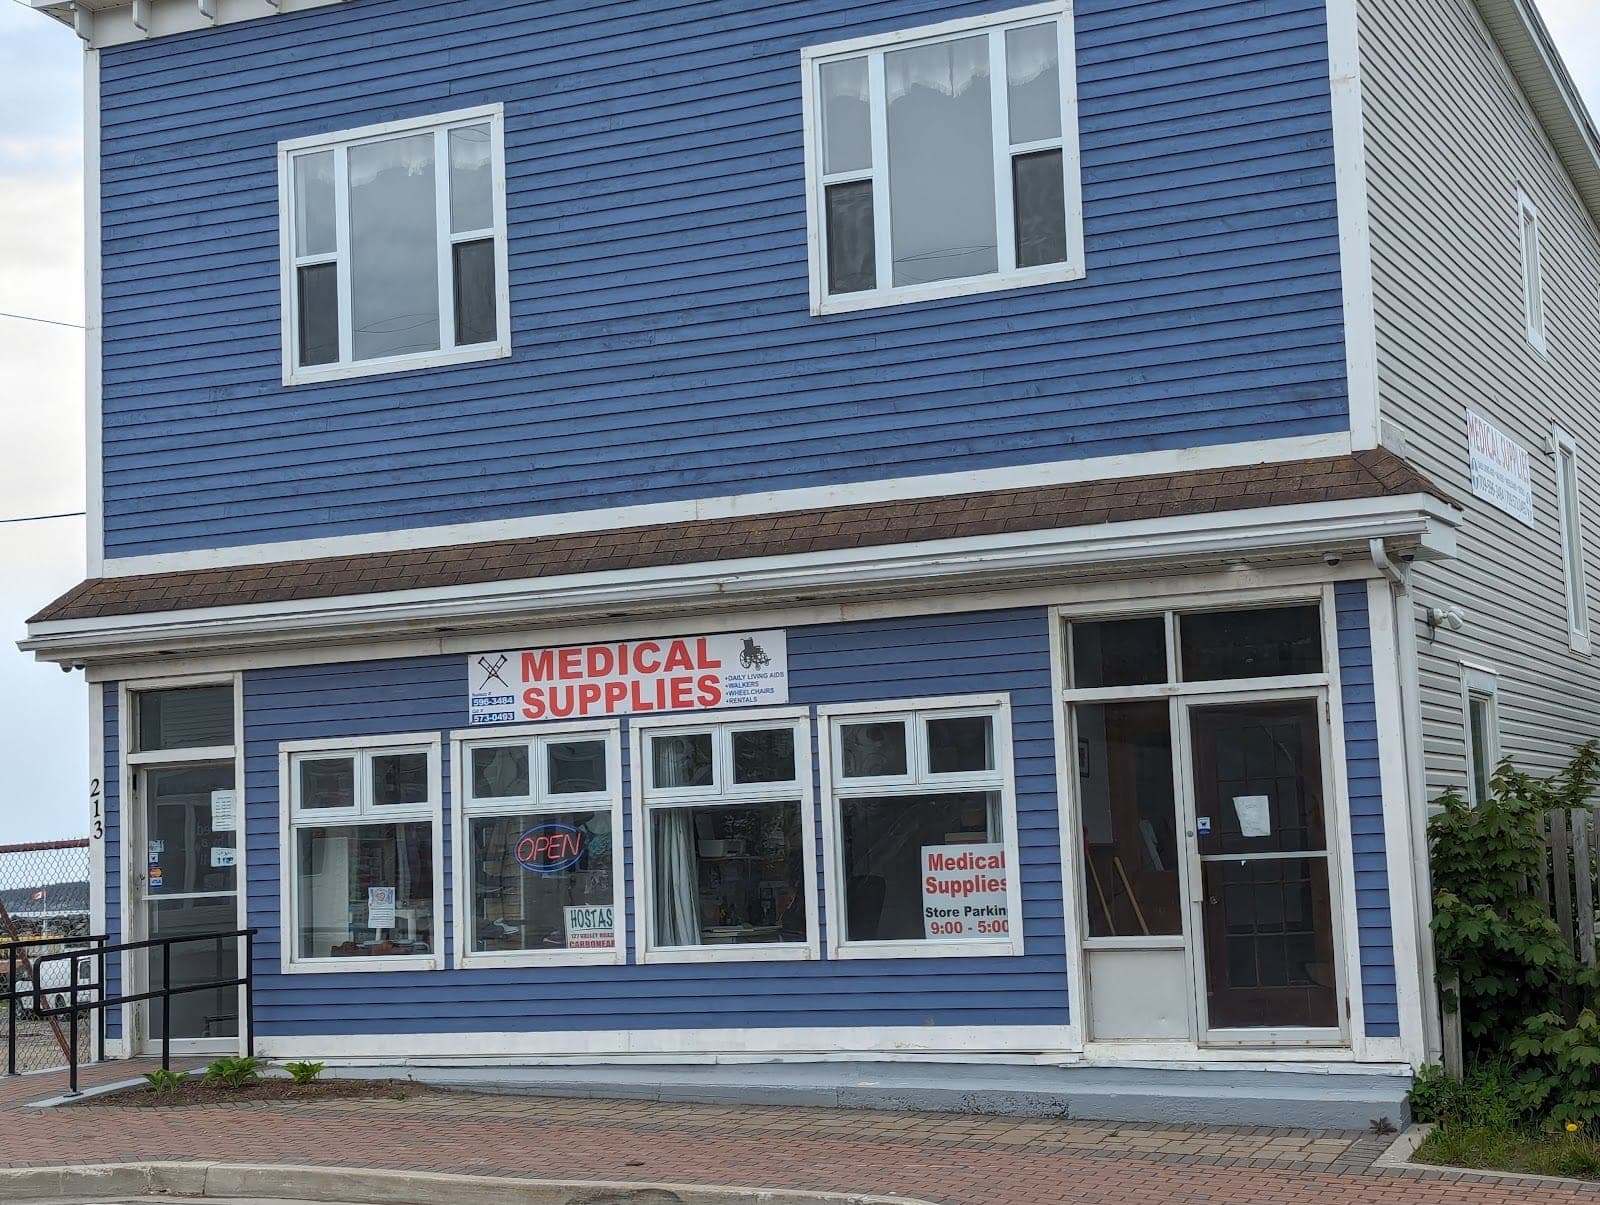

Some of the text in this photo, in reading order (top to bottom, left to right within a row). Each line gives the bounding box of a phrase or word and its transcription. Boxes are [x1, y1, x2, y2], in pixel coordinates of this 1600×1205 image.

[521, 637, 722, 683] MEDICAL
[747, 672, 768, 680] LIVING
[522, 674, 722, 720] SUPPLIES
[729, 696, 758, 704] RENTALS
[474, 712, 514, 722] 573-0493
[90, 778, 103, 840] 213
[517, 832, 581, 862] OPEN
[928, 850, 1006, 872] Medical
[925, 874, 1008, 898] Supplies
[570, 908, 613, 929] HOSTAS
[925, 904, 1008, 918] Store Parkin
[930, 921, 963, 935] 9:00
[977, 919, 1009, 934] 5:00
